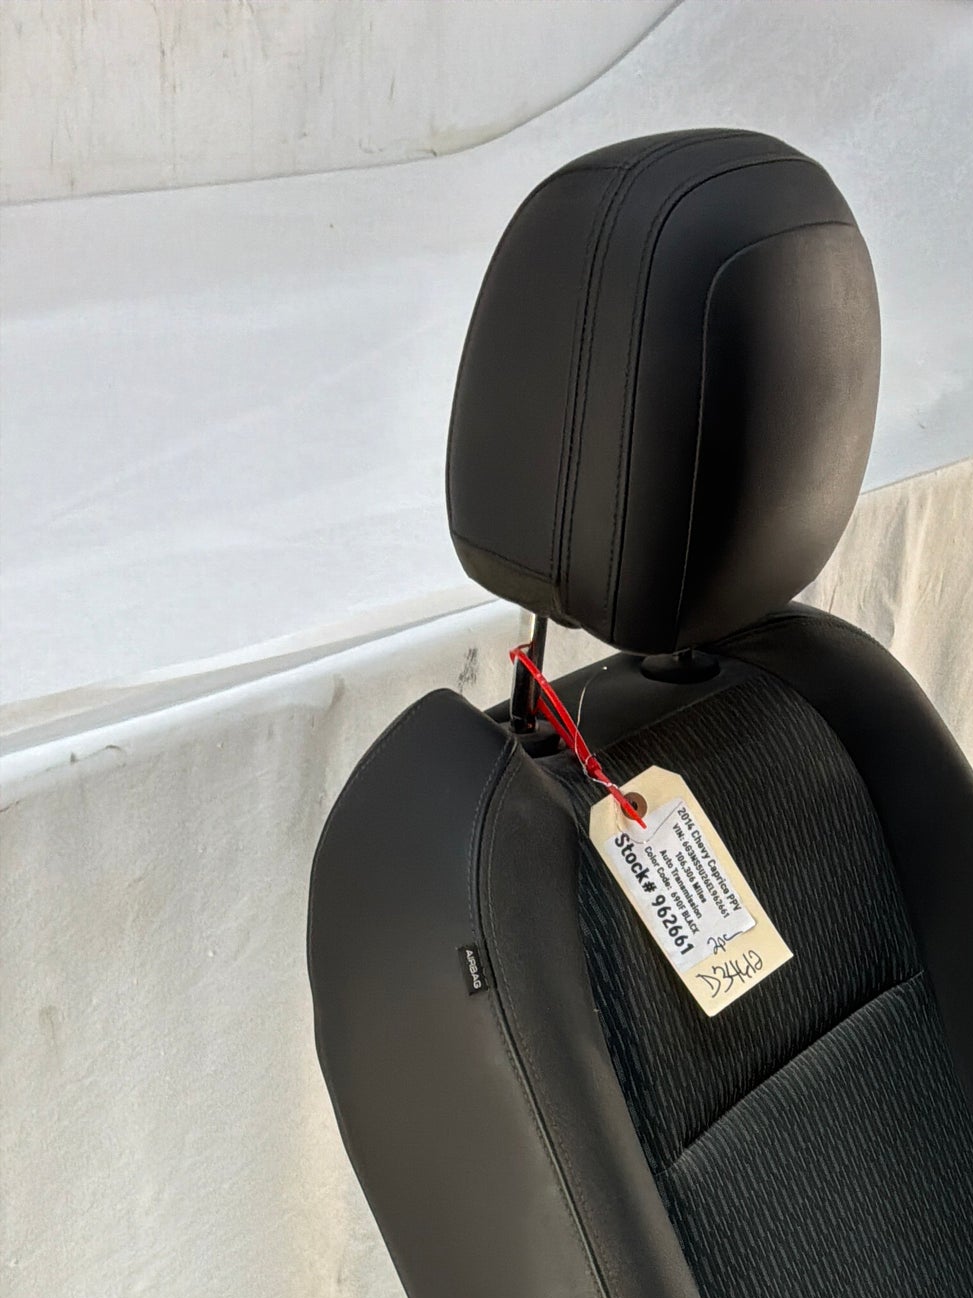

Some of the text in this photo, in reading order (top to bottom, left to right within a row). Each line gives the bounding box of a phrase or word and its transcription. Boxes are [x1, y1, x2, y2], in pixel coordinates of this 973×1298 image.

[672, 823, 685, 841] VIN:
[677, 807, 742, 911] 2014 Chevy Caprice PPV
[614, 832, 695, 955] Stock# 962661
[644, 846, 660, 867] Color
[656, 866, 672, 890] Code:
[681, 910, 700, 935] BLACK
[659, 849, 702, 919] Auto Transmission
[675, 851, 707, 904] 106,306 Miles
[465, 949, 482, 989] AIRBAG
